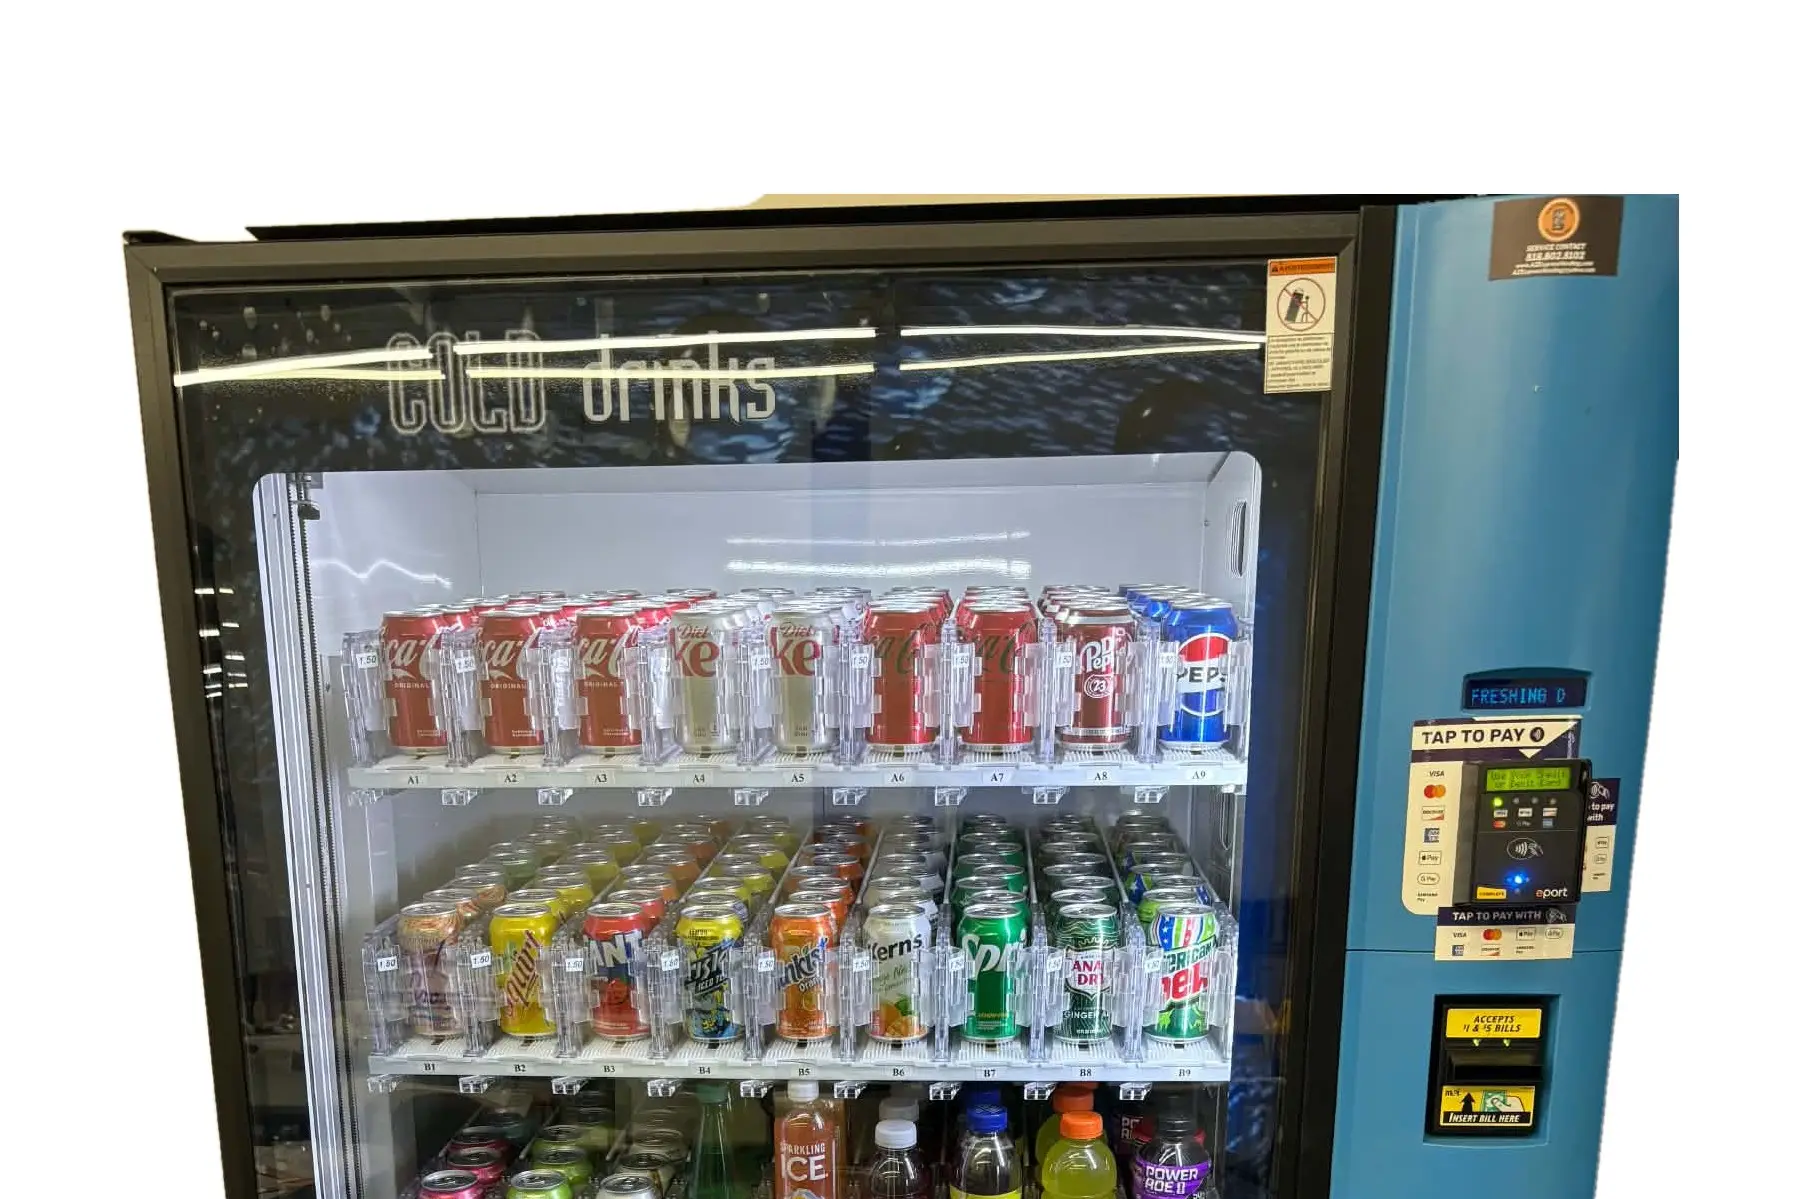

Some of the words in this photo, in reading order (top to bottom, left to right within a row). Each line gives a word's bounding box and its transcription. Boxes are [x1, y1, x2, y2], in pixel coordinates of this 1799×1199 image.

[386, 330, 547, 433] COLD
[582, 332, 777, 424] drinks
[359, 655, 377, 665] 1.50
[1472, 688, 1547, 706] FRESHING
[1422, 730, 1457, 744] TAP
[1461, 729, 1485, 742] TO
[1490, 728, 1526, 743] PAY
[504, 774, 518, 783] A2
[595, 774, 607, 782] A3
[791, 774, 805, 782] A5
[891, 774, 905, 782] A6
[991, 773, 1004, 782] A7
[1094, 772, 1108, 780] A8
[1192, 771, 1206, 780] A9
[408, 776, 420, 784] A1
[1452, 912, 1473, 921] TAP
[1475, 912, 1490, 921] TO
[1493, 912, 1514, 921] PAY
[1515, 911, 1542, 920] WITH
[589, 931, 644, 968] ANT
[961, 927, 1027, 979] Spri
[1072, 960, 1104, 972] ANA
[1473, 1015, 1515, 1023] ACCEPTS
[1494, 1024, 1522, 1032] BILLS
[424, 1063, 436, 1071] B1
[514, 1064, 526, 1072] B2
[604, 1065, 616, 1073] B3
[699, 1066, 711, 1074] B4
[798, 1068, 810, 1076] B5
[893, 1068, 905, 1076] B6
[984, 1069, 996, 1077] B7
[1080, 1069, 1092, 1077] B8
[1449, 1113, 1477, 1123] INSERT
[1478, 1113, 1496, 1122] BILL
[1498, 1113, 1520, 1122] HERE
[781, 1156, 826, 1181] ICE
